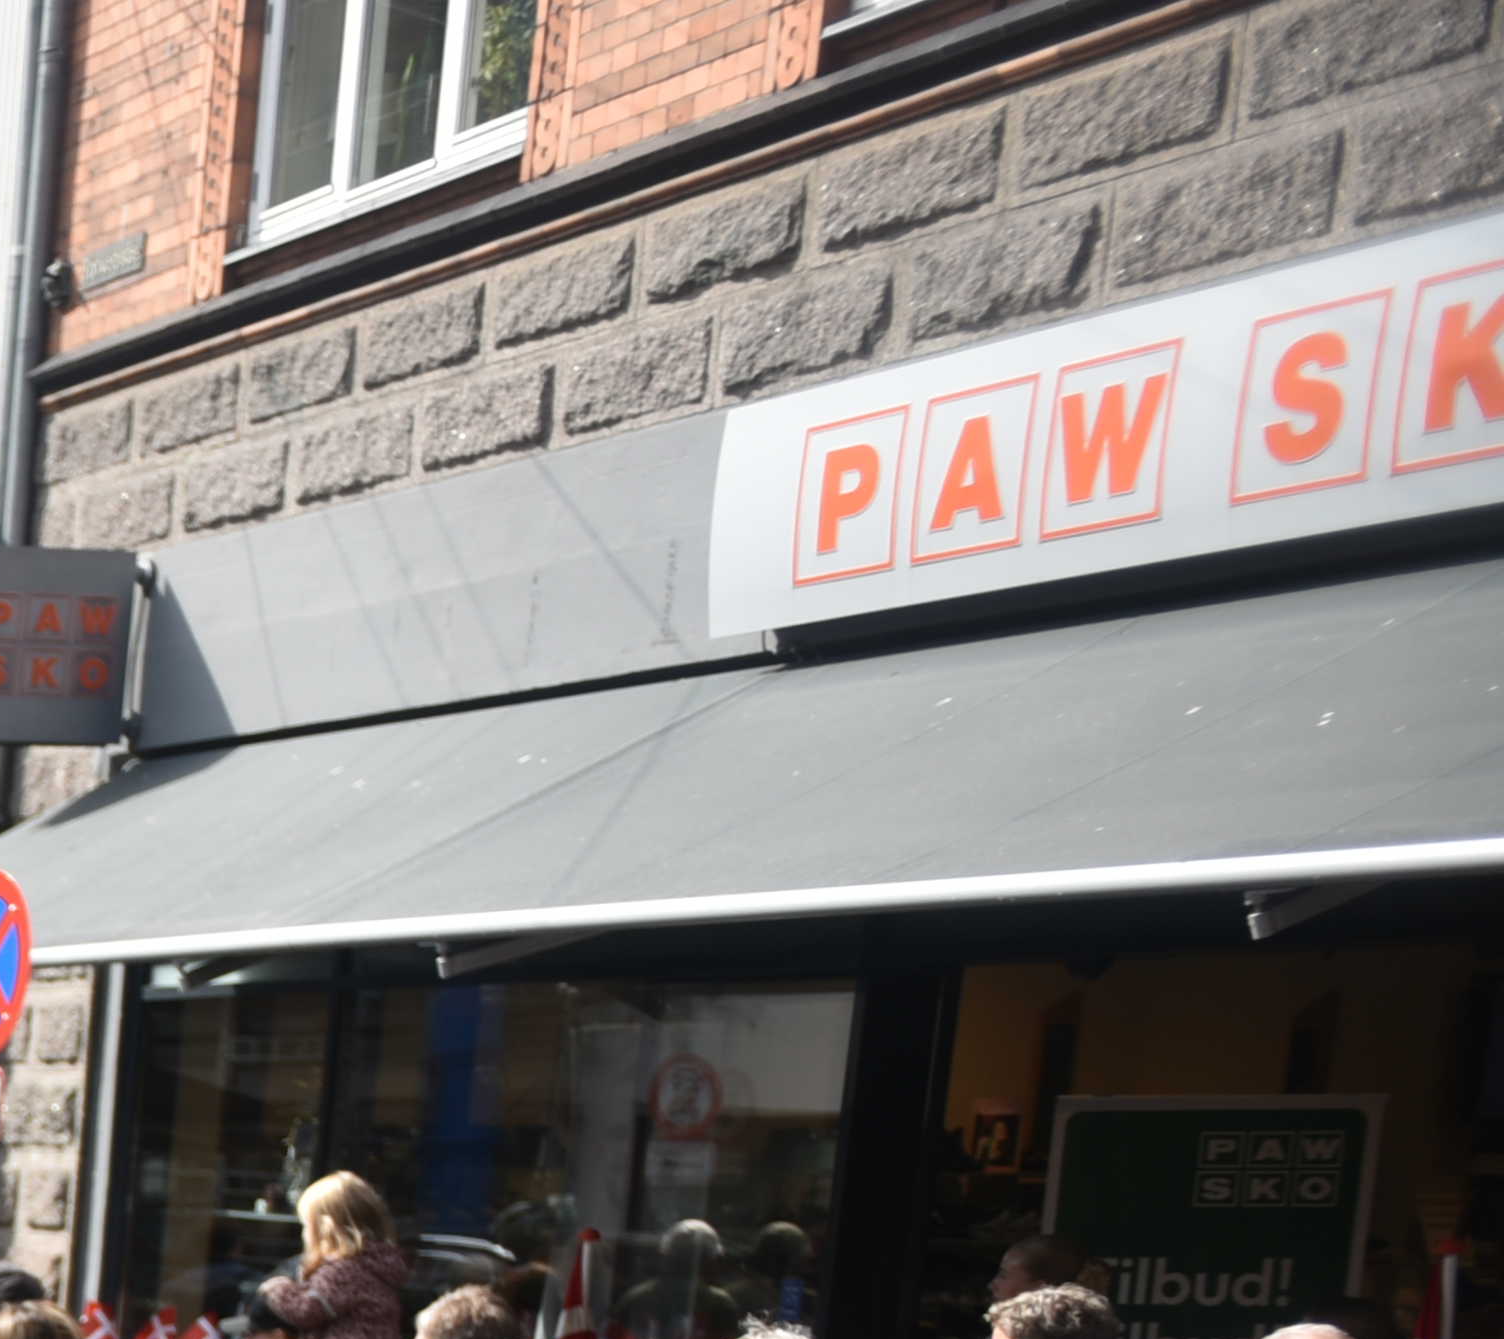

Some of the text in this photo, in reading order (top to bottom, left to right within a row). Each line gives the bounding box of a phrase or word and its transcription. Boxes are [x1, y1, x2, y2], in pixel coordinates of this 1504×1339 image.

[816, 374, 1167, 556] PAW
[1206, 1138, 1341, 1162] PAW
[1199, 1176, 1331, 1201] SKO
[1103, 1255, 1295, 1307] ilbud!
